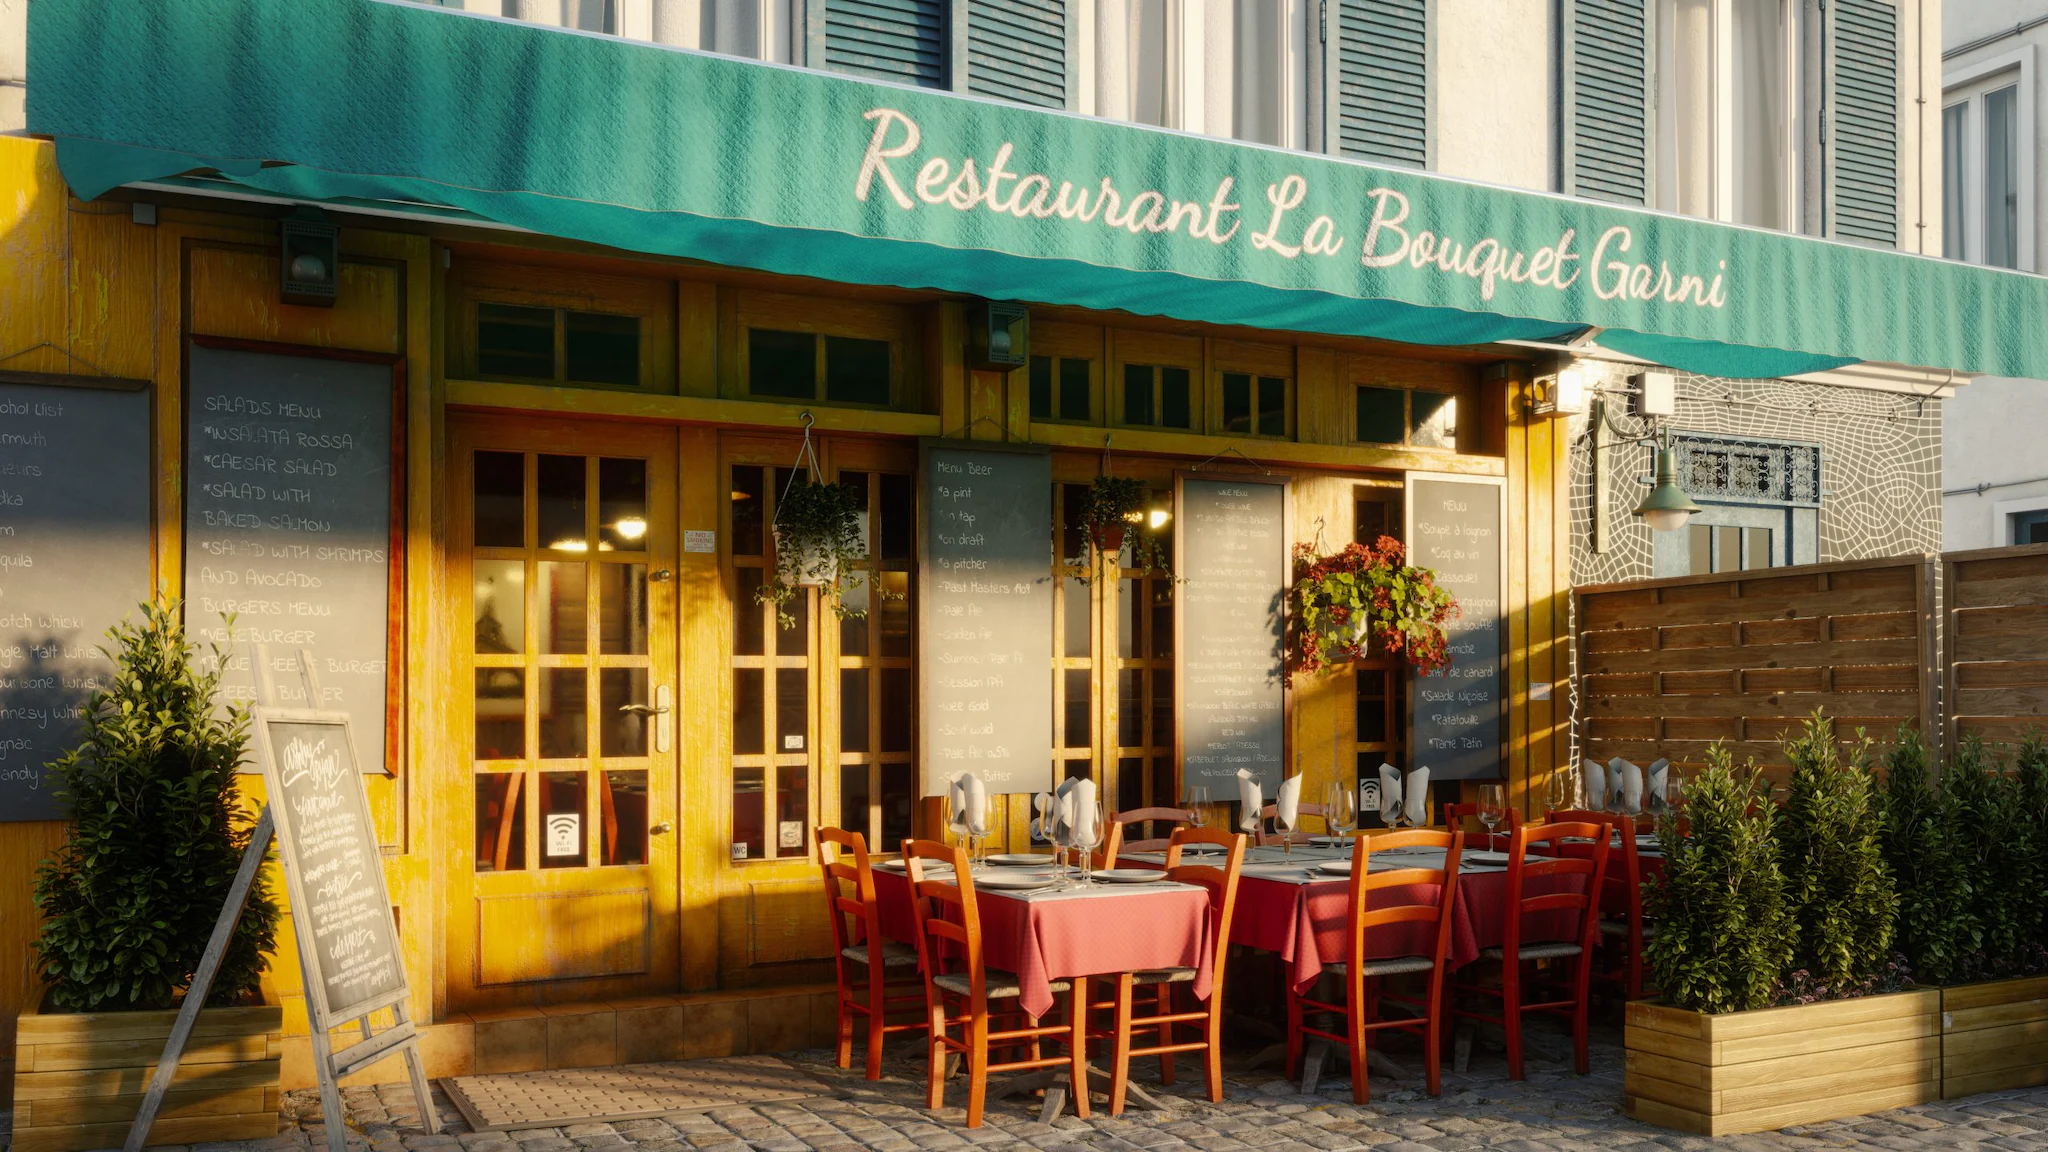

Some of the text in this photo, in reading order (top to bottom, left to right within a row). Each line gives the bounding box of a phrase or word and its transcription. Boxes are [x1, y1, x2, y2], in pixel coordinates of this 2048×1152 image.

[855, 107, 1727, 308] Restaurant La Bouquet Garni
[204, 395, 321, 419] SALADS MENU
[296, 432, 353, 450] ROSSA
[283, 458, 337, 477] SALAD
[937, 461, 993, 476] Menu Beer
[272, 488, 311, 503] WITH
[953, 486, 972, 502] pint
[1443, 500, 1467, 512] MENU
[203, 510, 261, 529] BAKED
[959, 510, 976, 528] tap
[959, 532, 985, 546] draft
[271, 544, 309, 560] WITH
[316, 547, 384, 563] SHRIMPS
[1454, 549, 1465, 559] au
[1468, 547, 1480, 559] vin
[953, 556, 988, 574] pitcher
[201, 567, 322, 588] AND AVOCADO
[970, 581, 1010, 594] Masters
[200, 597, 331, 617] BURGERS MENU
[30, 644, 57, 659] Malt
[1450, 665, 1460, 678] de
[1464, 665, 1493, 678] canard
[1461, 737, 1482, 749] Tatin
[982, 769, 1012, 782] Bitter
[733, 846, 747, 854] WC
